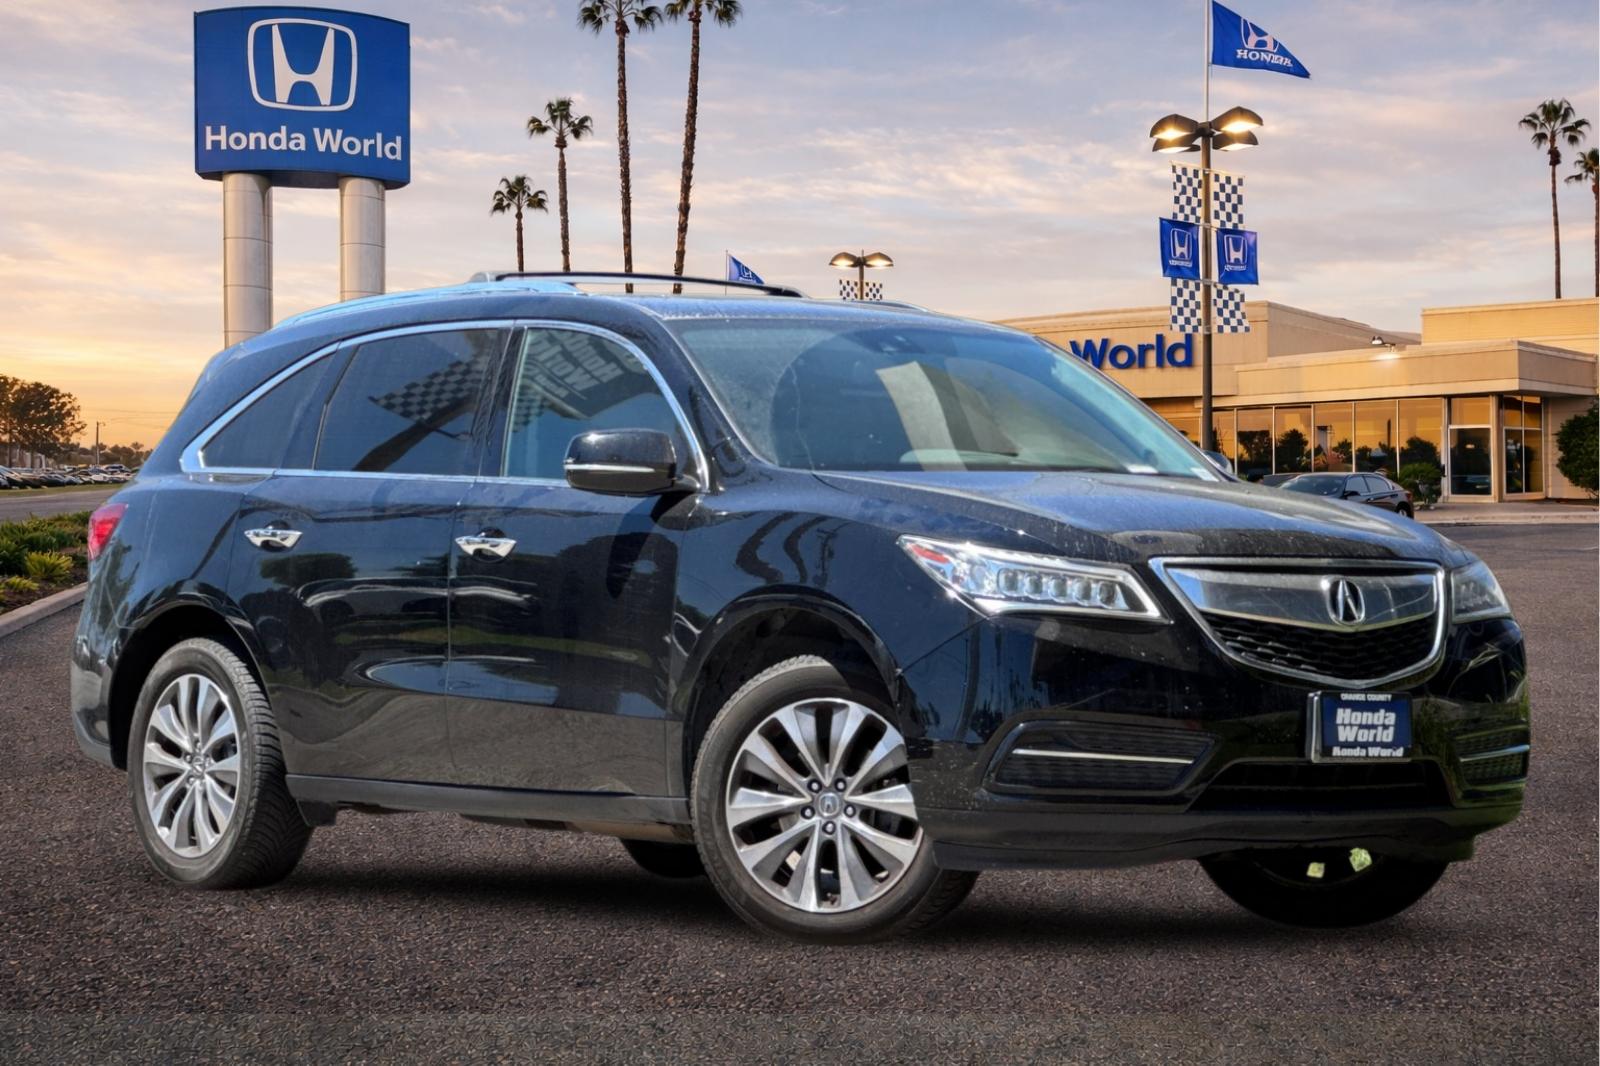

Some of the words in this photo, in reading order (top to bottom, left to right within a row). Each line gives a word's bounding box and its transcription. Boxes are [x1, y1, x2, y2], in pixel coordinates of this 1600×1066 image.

[205, 125, 306, 151] Honda
[313, 127, 402, 160] World
[1069, 333, 1193, 369] World
[1336, 708, 1396, 725] Honda
[1338, 725, 1395, 742] World
